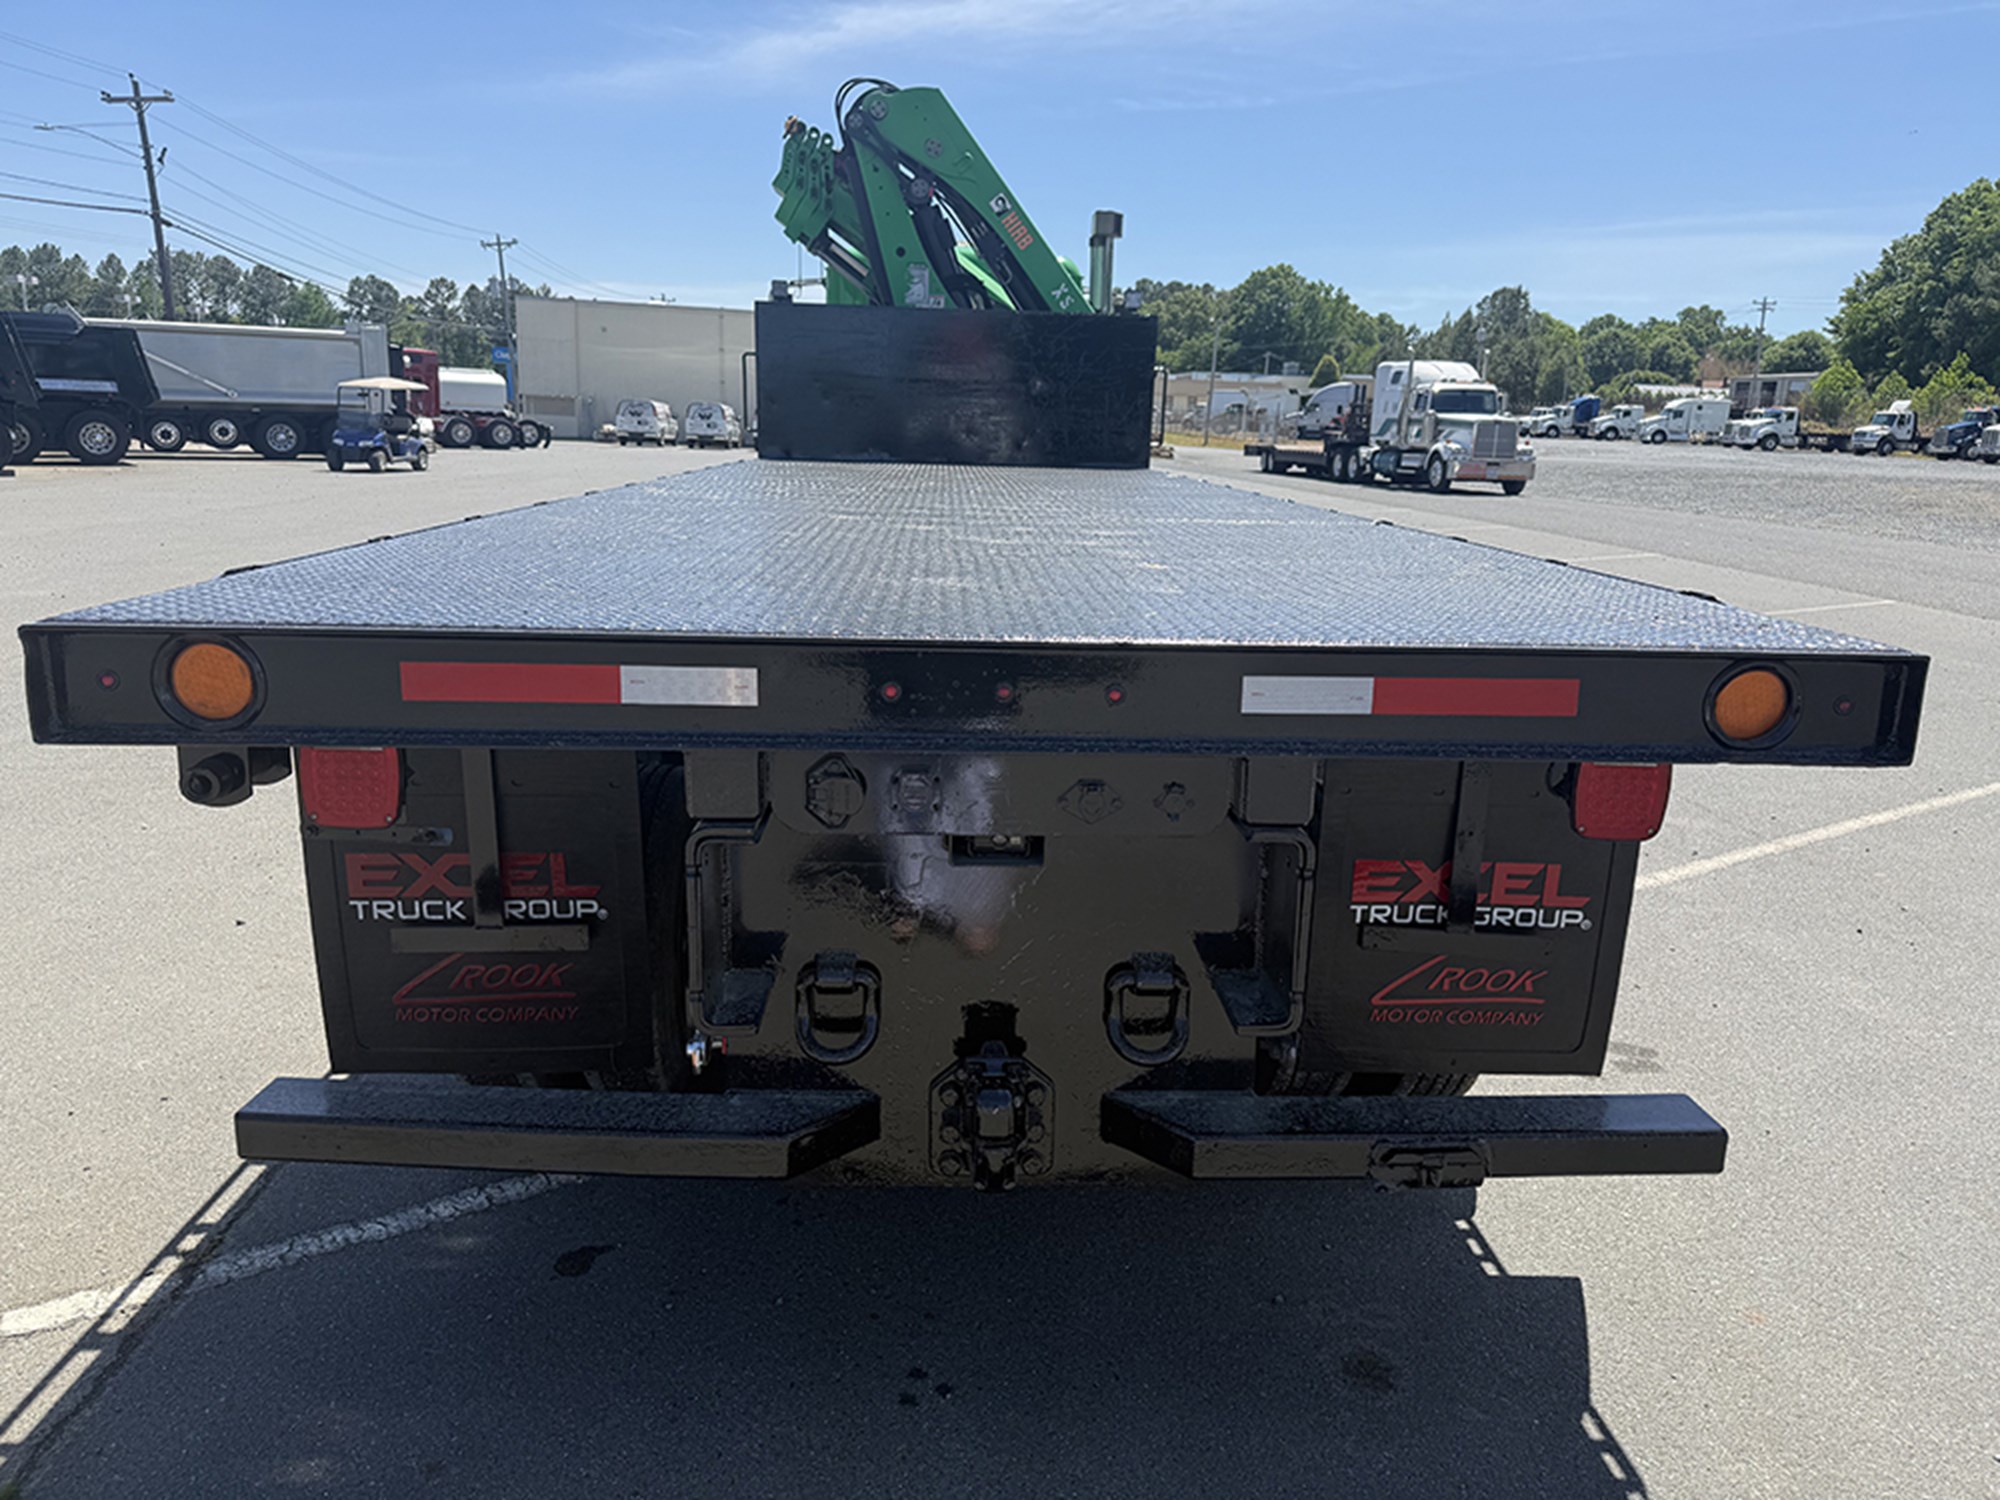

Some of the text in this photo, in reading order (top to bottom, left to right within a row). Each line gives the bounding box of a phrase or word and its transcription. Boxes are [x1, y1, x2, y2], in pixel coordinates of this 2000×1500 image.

[1001, 211, 1035, 251] HIAB
[349, 900, 601, 920] TRUCK ROUP
[395, 1006, 580, 1024] MOTOR COMPANY
[1369, 1009, 1545, 1027] MOTOR COMPANY
